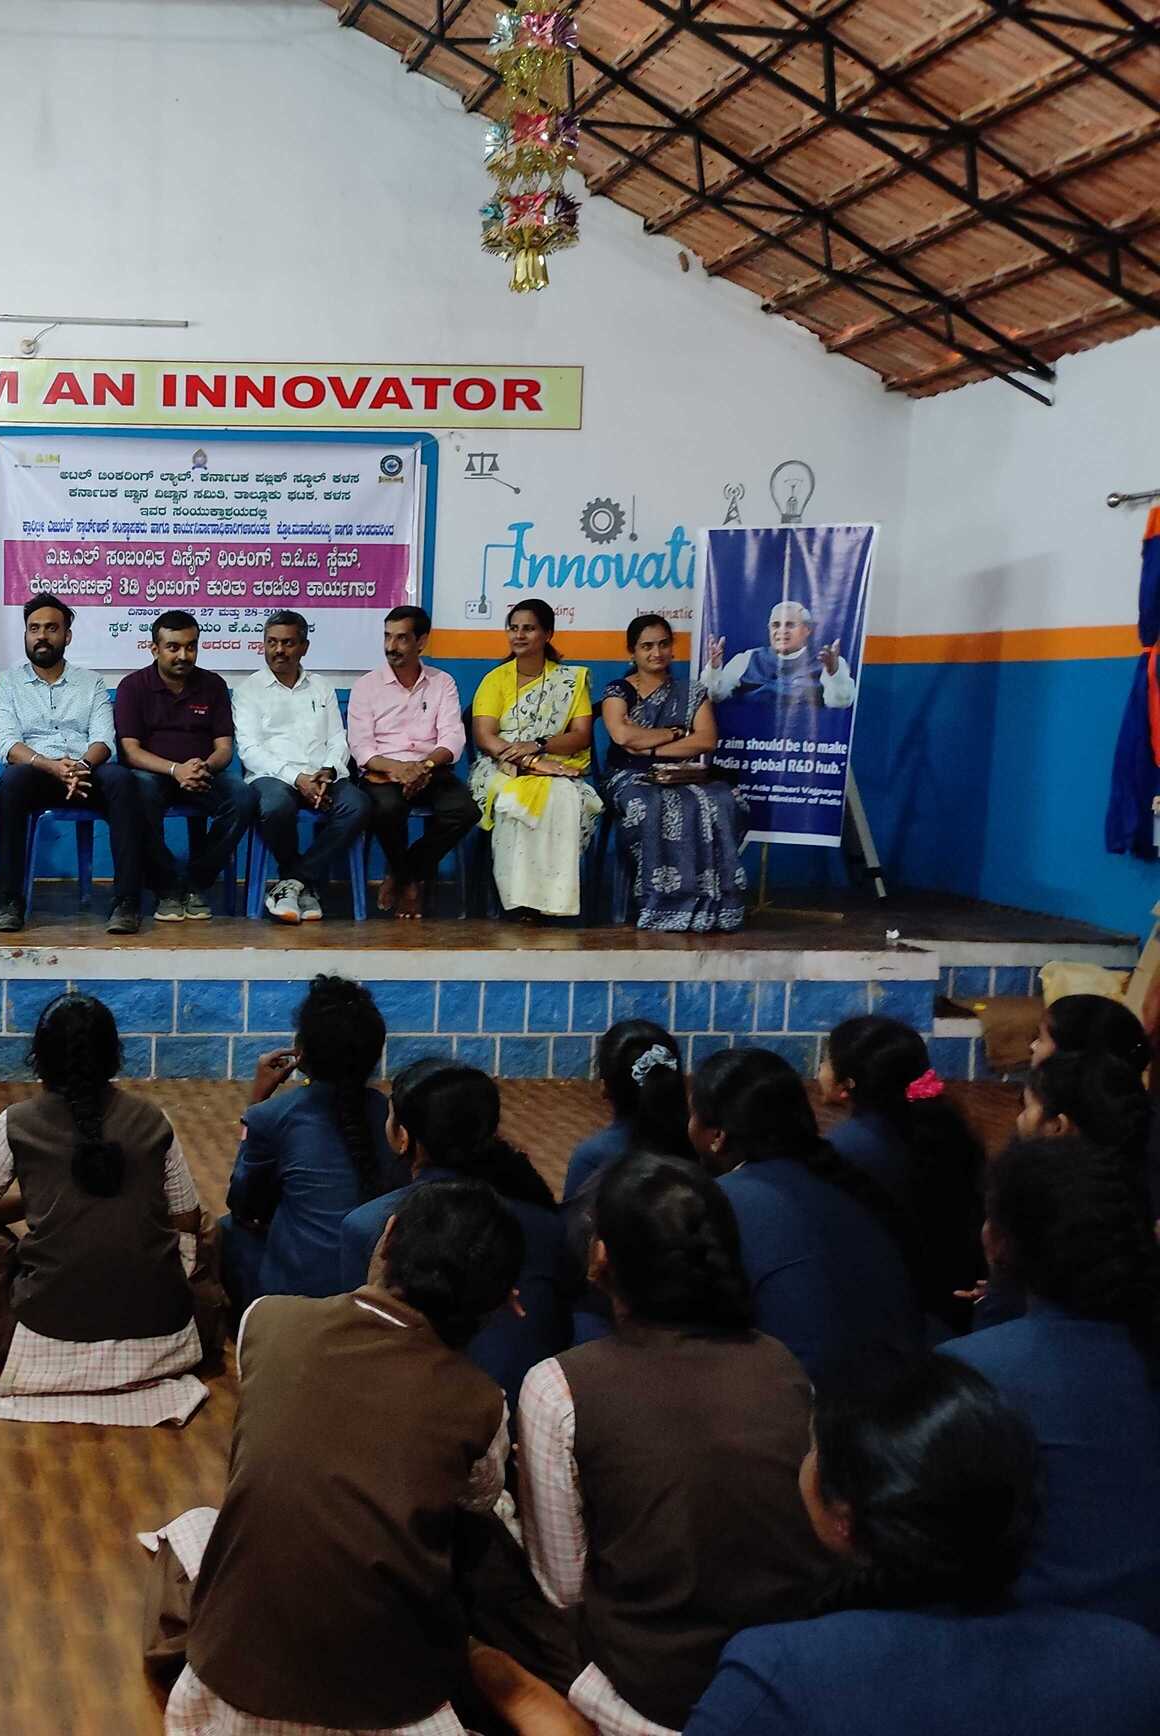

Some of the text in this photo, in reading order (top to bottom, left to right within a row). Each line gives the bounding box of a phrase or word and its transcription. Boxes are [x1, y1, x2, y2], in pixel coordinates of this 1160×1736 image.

[42, 372, 136, 407] AN
[162, 373, 544, 412] INNOVATOR
[503, 521, 697, 590] Innovati
[200, 608, 214, 617] 27
[724, 737, 744, 750] aim
[746, 738, 784, 752] should
[786, 739, 801, 752] be
[802, 741, 816, 753] to
[817, 741, 847, 754] make
[741, 760, 749, 770] a
[750, 758, 786, 774] global
[787, 759, 814, 773] R&D
